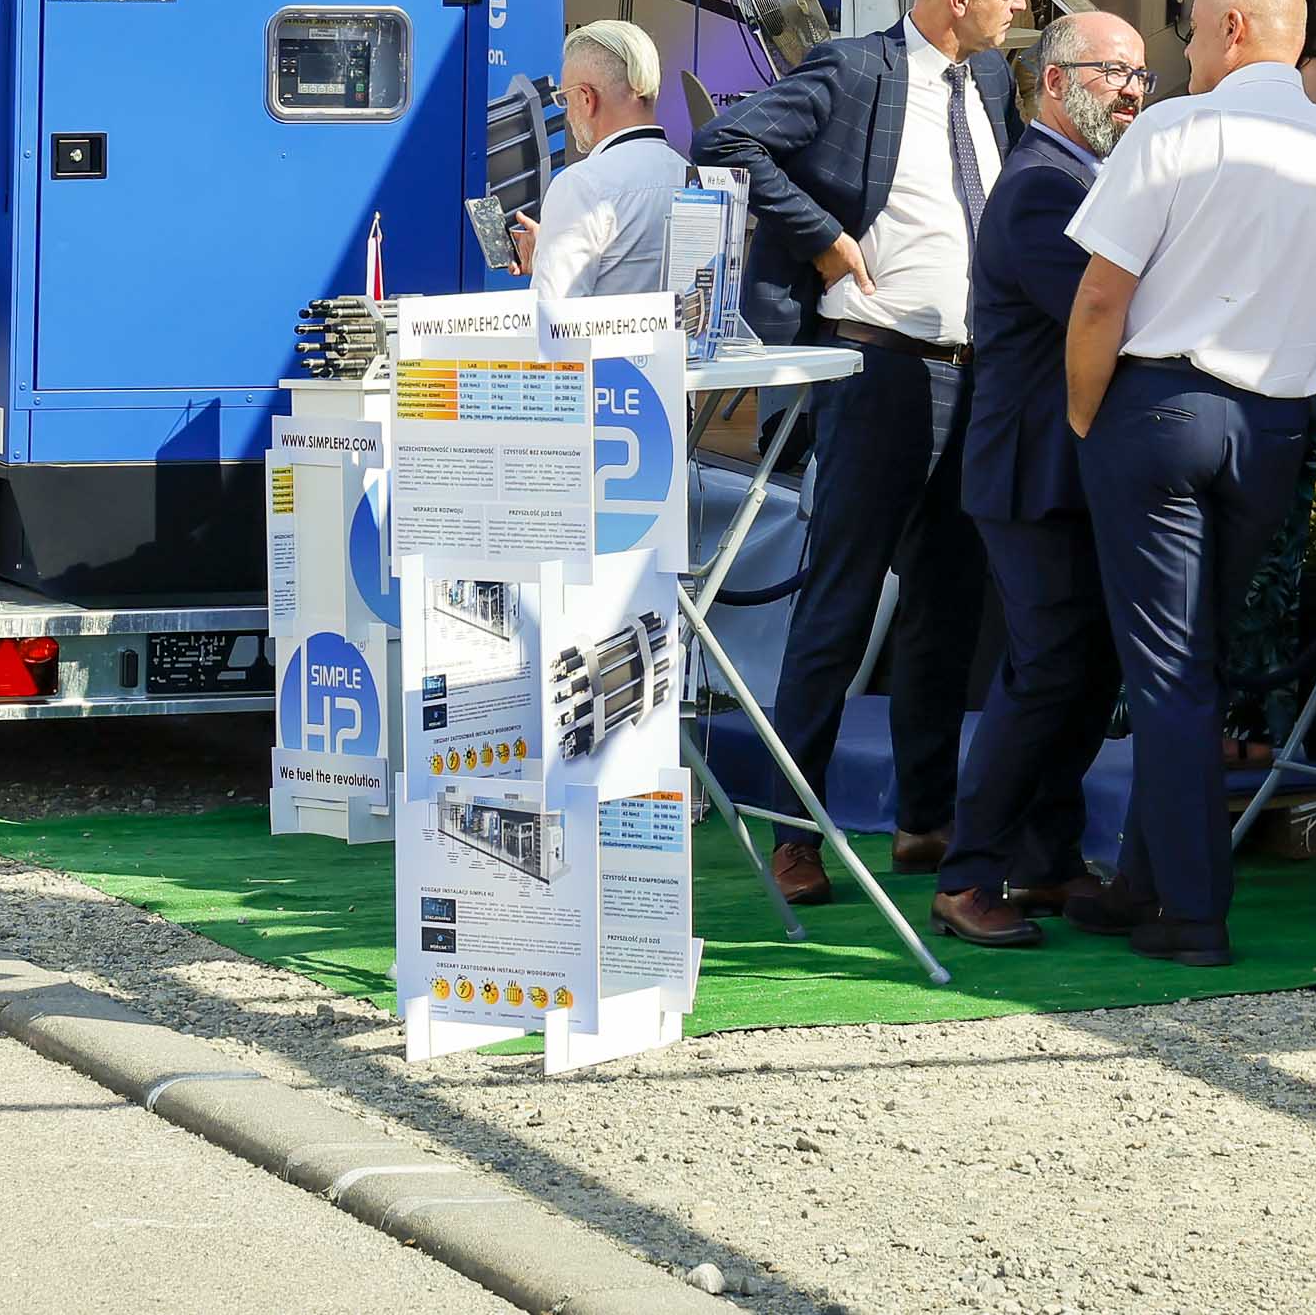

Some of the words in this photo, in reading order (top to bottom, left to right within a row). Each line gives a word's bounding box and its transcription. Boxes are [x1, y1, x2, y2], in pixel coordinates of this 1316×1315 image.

[411, 313, 531, 336] WWW.SIMPLEH2.COM
[550, 316, 668, 339] WWW.SIMPLEH2.COM
[594, 387, 640, 416] PLE
[281, 434, 377, 452] WWW.SIMPLEH2.COM
[311, 665, 361, 689] SIMPLE
[280, 765, 294, 780] We
[297, 767, 314, 782] fuel
[316, 769, 331, 784] the
[333, 773, 380, 789] revolution
